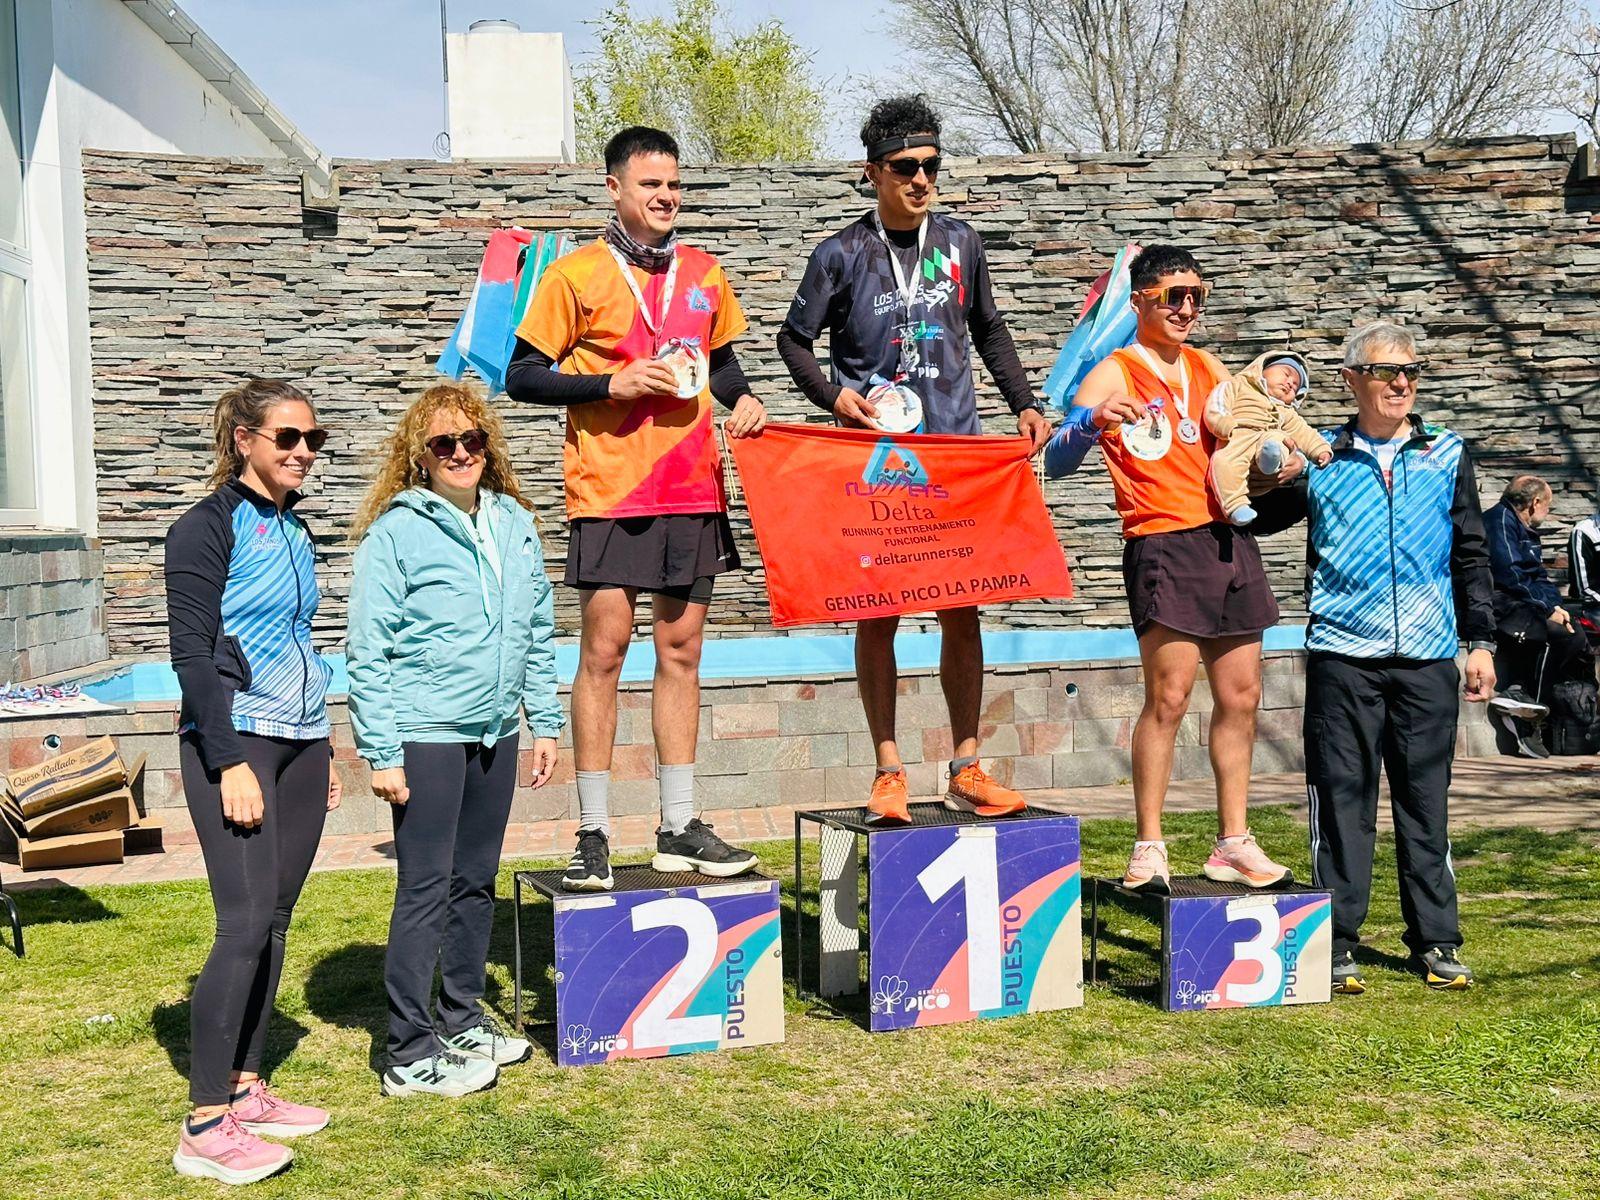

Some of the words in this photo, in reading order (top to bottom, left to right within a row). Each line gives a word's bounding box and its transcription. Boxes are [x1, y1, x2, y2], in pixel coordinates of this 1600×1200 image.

[874, 291, 893, 308] LOS
[871, 500, 937, 522] Delta
[841, 526, 884, 537] RUNNING
[886, 527, 892, 536] Y
[894, 519, 976, 535] ENTRENAMIENTO
[884, 534, 940, 547] FUNCIONAL
[874, 546, 974, 566] deltarunnersgp
[825, 592, 898, 611] GENERAL
[901, 585, 941, 604] PICO
[945, 580, 967, 596] LA
[970, 573, 1031, 593] PAMPA
[13, 773, 40, 788] Queso
[41, 757, 77, 777] Rallado
[916, 827, 1002, 1011] 1
[1003, 905, 1023, 1008] PUESTO
[1226, 901, 1283, 1004] 3
[1284, 927, 1297, 998] PUESTO
[631, 897, 722, 1050] 2
[725, 948, 745, 1040] PUESTO
[905, 993, 950, 1012] PICO
[1193, 993, 1221, 1005] PICO
[589, 1037, 629, 1054] PICO
